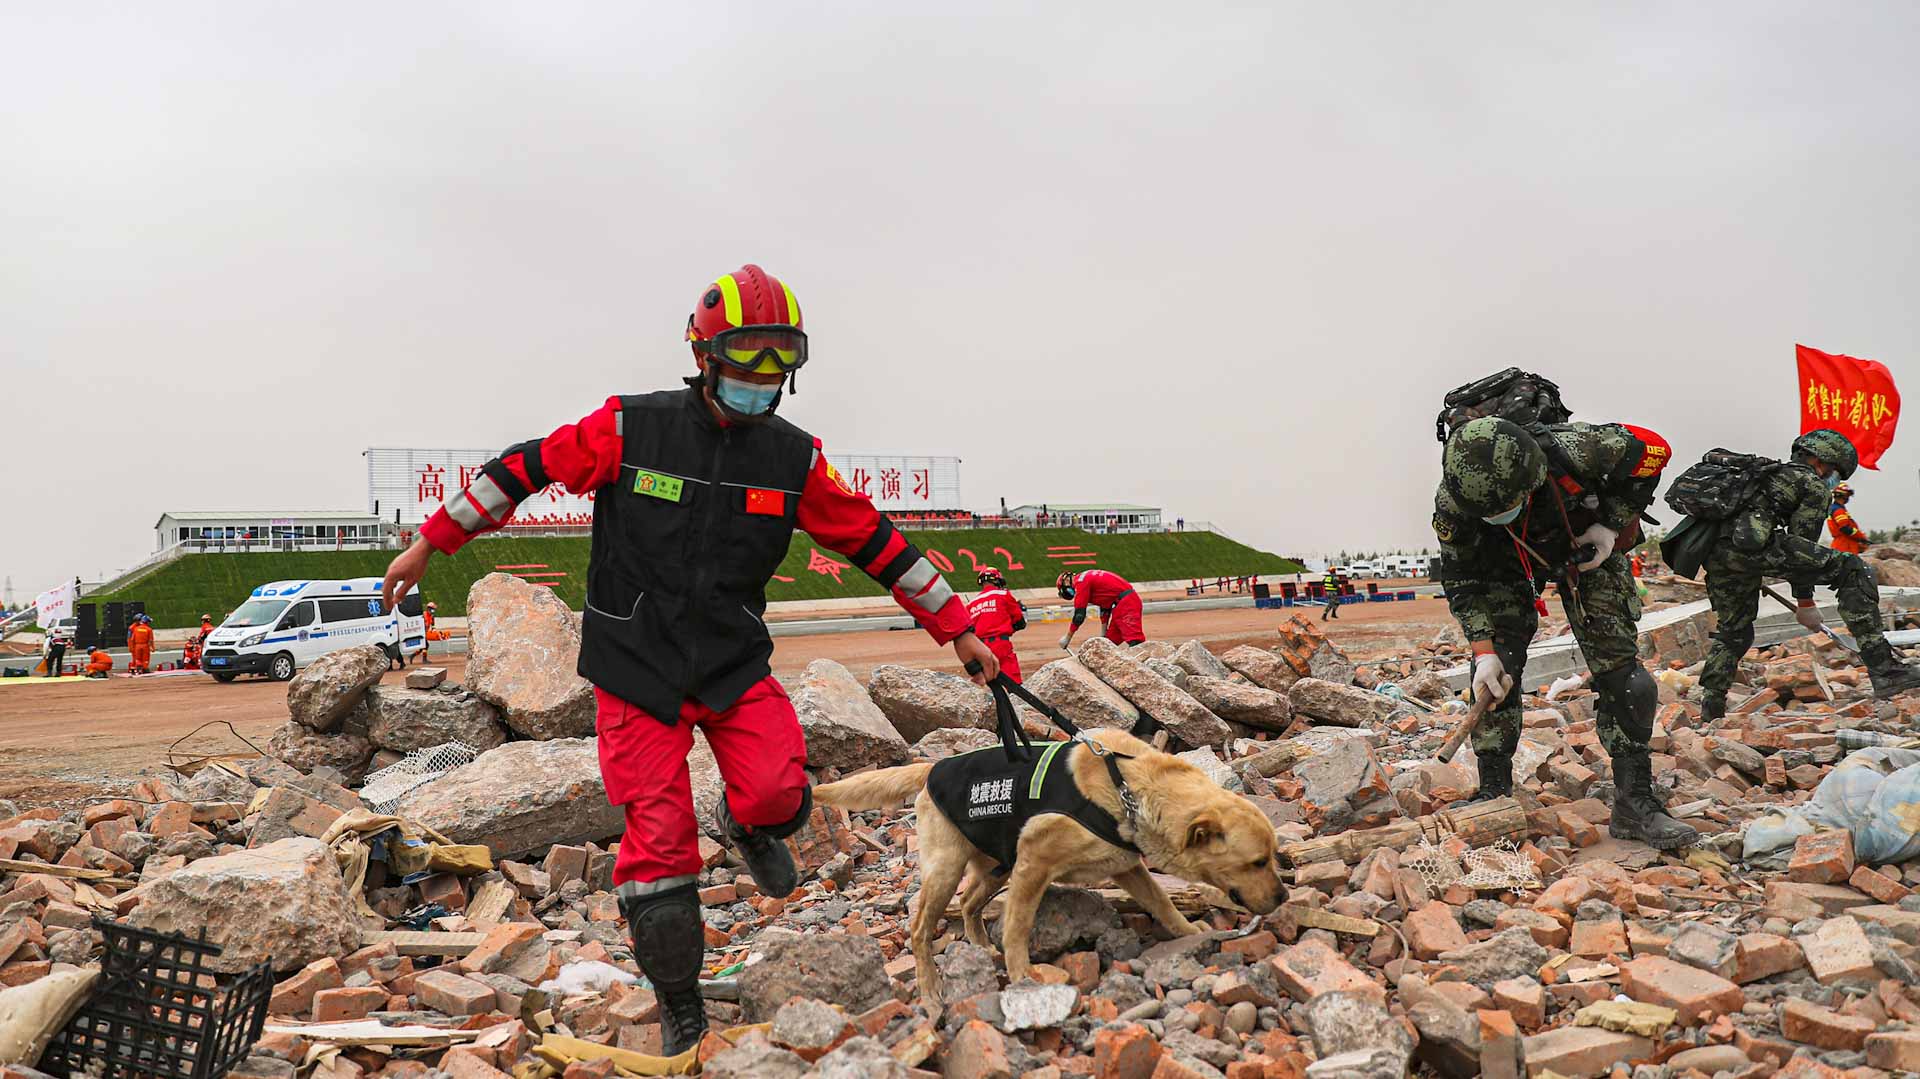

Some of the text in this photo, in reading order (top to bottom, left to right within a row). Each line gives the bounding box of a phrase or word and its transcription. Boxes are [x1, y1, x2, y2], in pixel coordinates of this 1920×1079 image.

[1807, 378, 1893, 430] 武警甘省队
[851, 467, 929, 501] 化演习
[970, 778, 1014, 804] 地震救援
